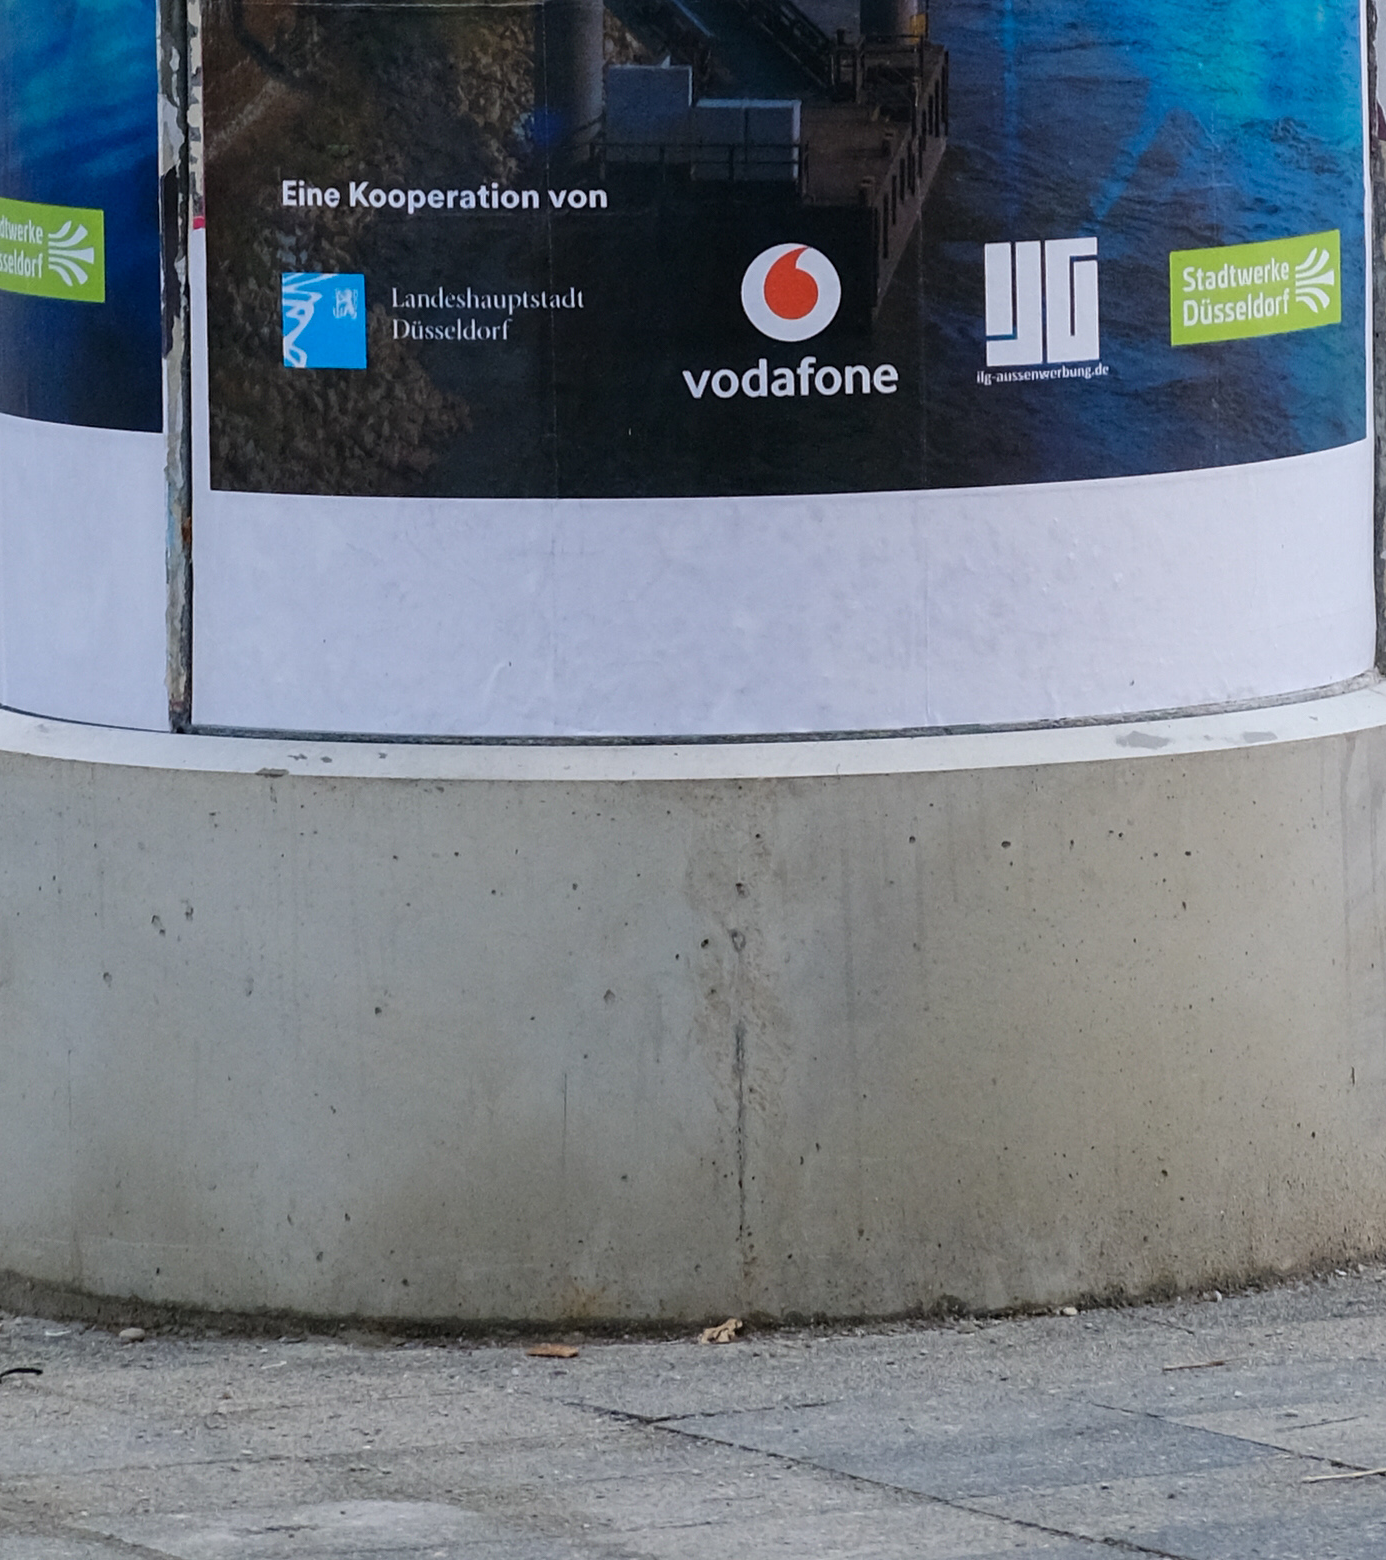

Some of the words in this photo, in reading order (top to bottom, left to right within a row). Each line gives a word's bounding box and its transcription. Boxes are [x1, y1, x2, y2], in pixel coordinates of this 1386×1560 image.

[282, 179, 341, 209] Eine
[349, 180, 541, 215] Kooperation
[548, 186, 609, 209] von
[1182, 257, 1290, 293] Stadtwerke
[391, 286, 585, 315] Landeshauptstadt
[1183, 287, 1290, 327] Düsseldorf
[391, 318, 514, 342] Düsseldorf
[682, 356, 900, 399] vodafone
[976, 362, 1110, 386] ilg-aussenwerbung.de
